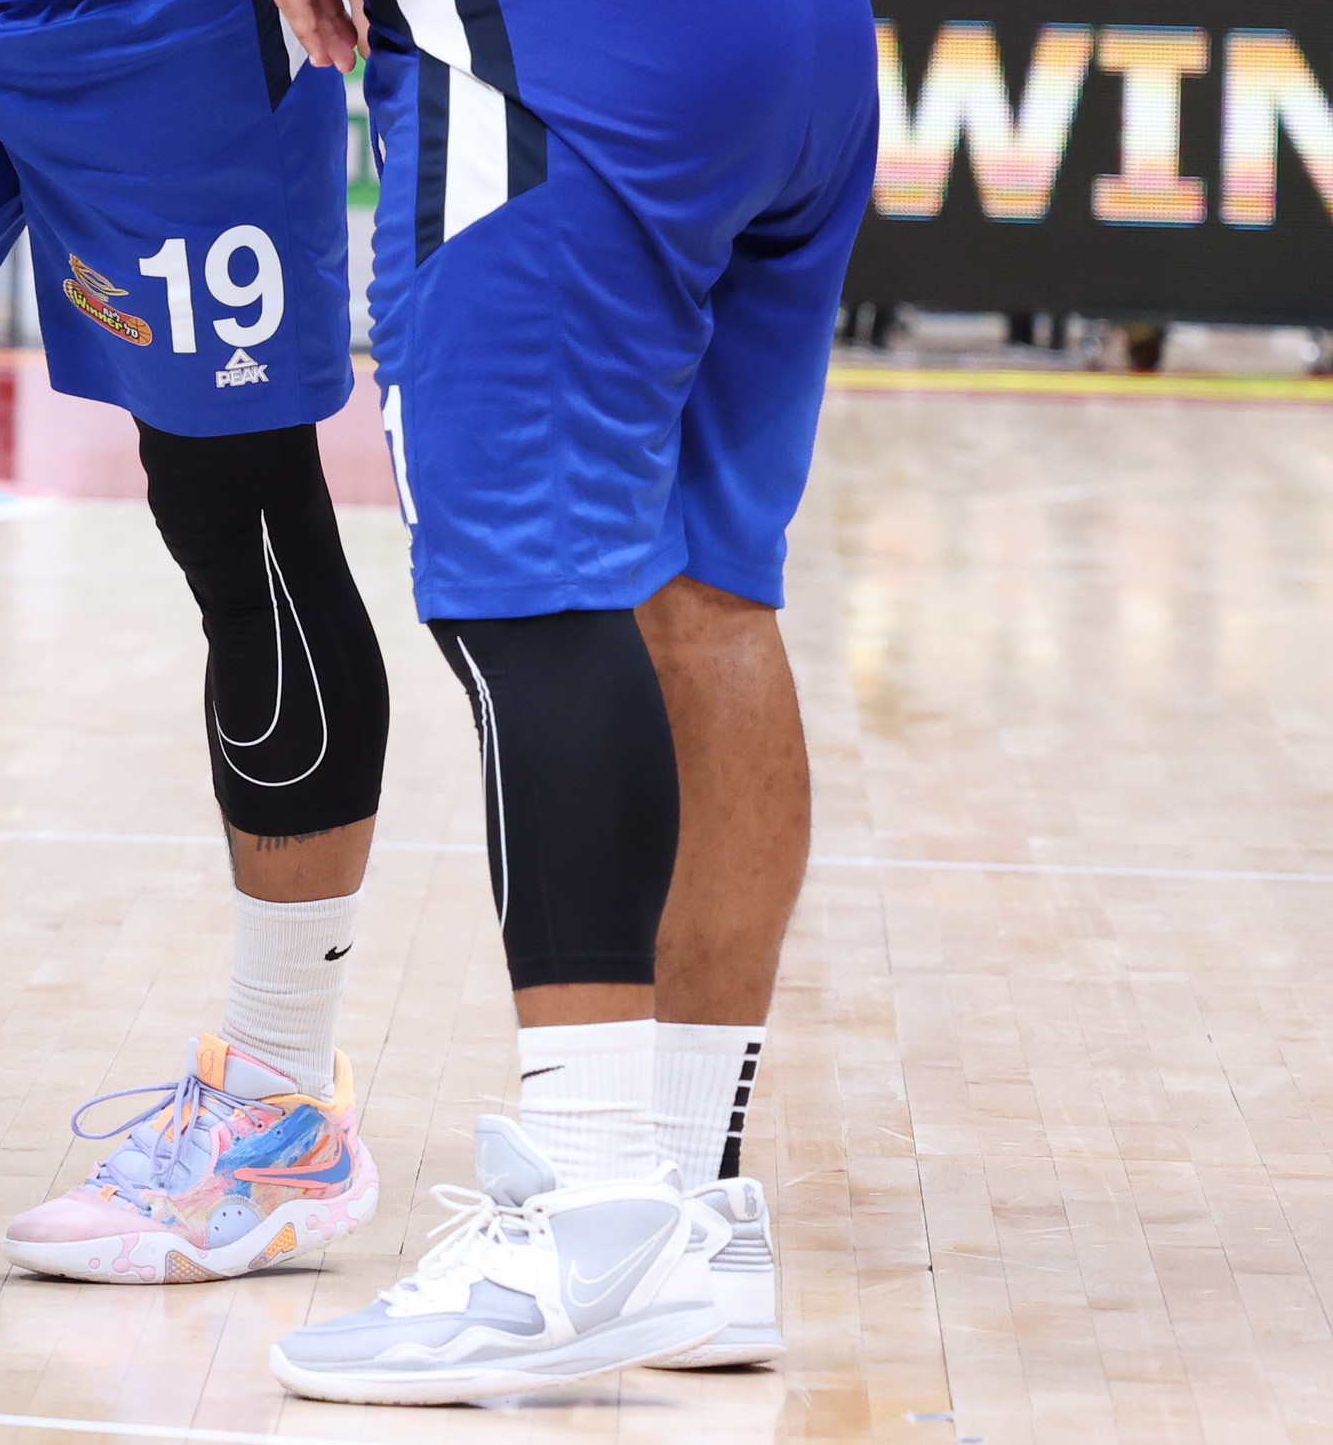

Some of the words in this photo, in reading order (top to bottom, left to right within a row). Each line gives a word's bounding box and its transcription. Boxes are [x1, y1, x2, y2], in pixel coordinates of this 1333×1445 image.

[139, 224, 285, 354] 19
[73, 290, 123, 330] Winner
[215, 364, 269, 388] PEAK
